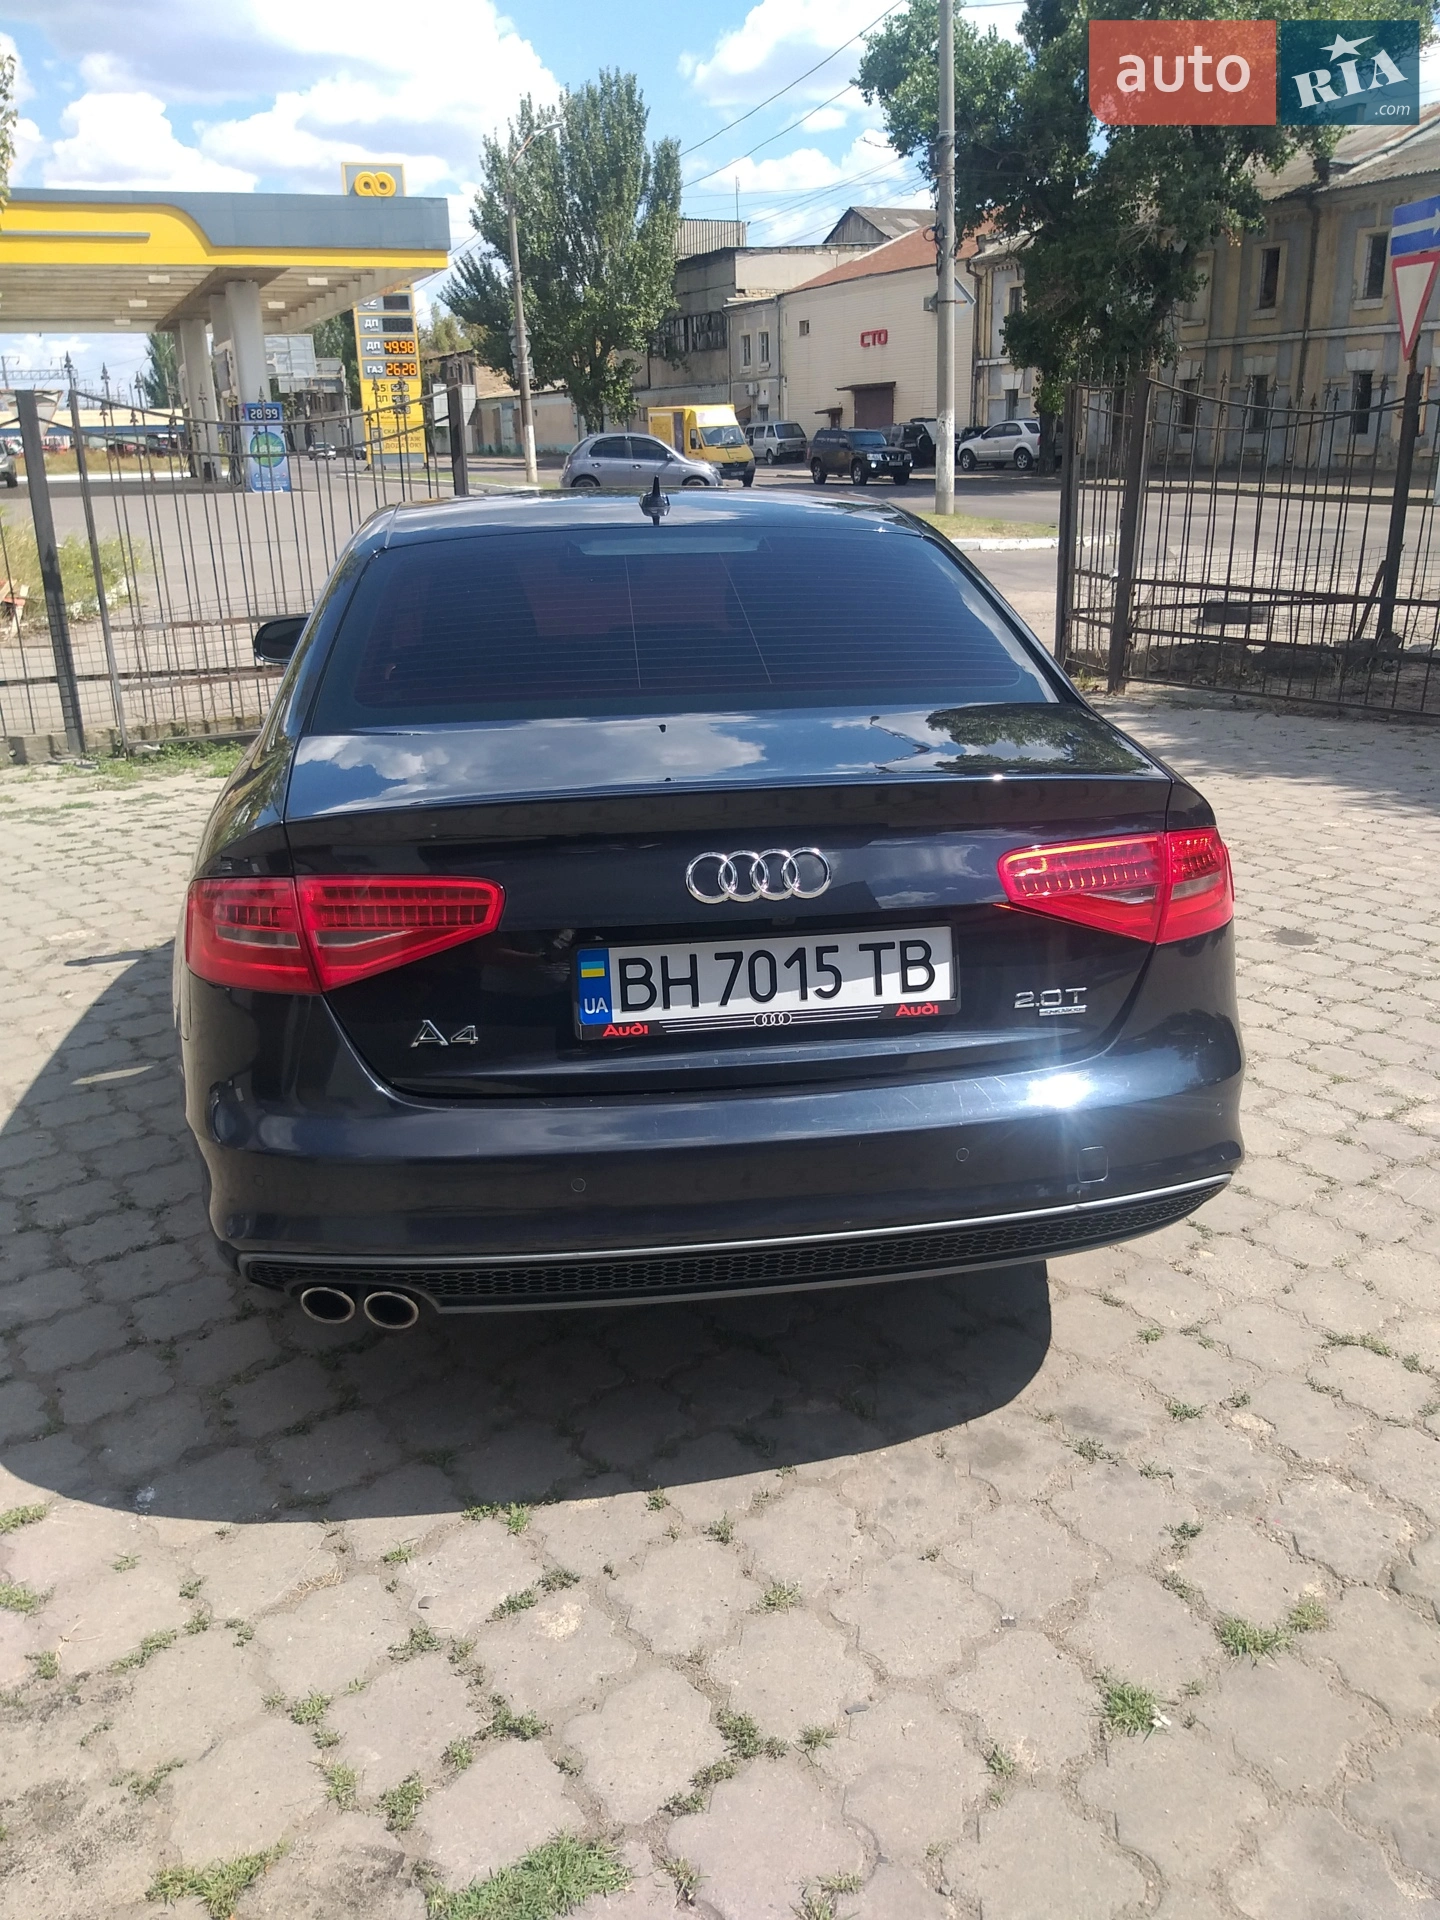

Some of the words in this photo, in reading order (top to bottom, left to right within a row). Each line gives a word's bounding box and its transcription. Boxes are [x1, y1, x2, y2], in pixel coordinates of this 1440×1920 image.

[364, 319, 379, 329] ДП
[860, 328, 888, 348] СТО
[366, 341, 381, 351] ДП
[383, 340, 415, 354] 49.98
[366, 365, 384, 374] ГАЗ
[618, 952, 700, 1014] BH
[714, 945, 843, 1007] 7015
[858, 939, 936, 996] TB
[584, 997, 609, 1015] UA
[1014, 987, 1088, 1009] 2.0T
[895, 1003, 940, 1017] Audi
[410, 1019, 479, 1048] A4
[602, 1023, 649, 1038] Audi
